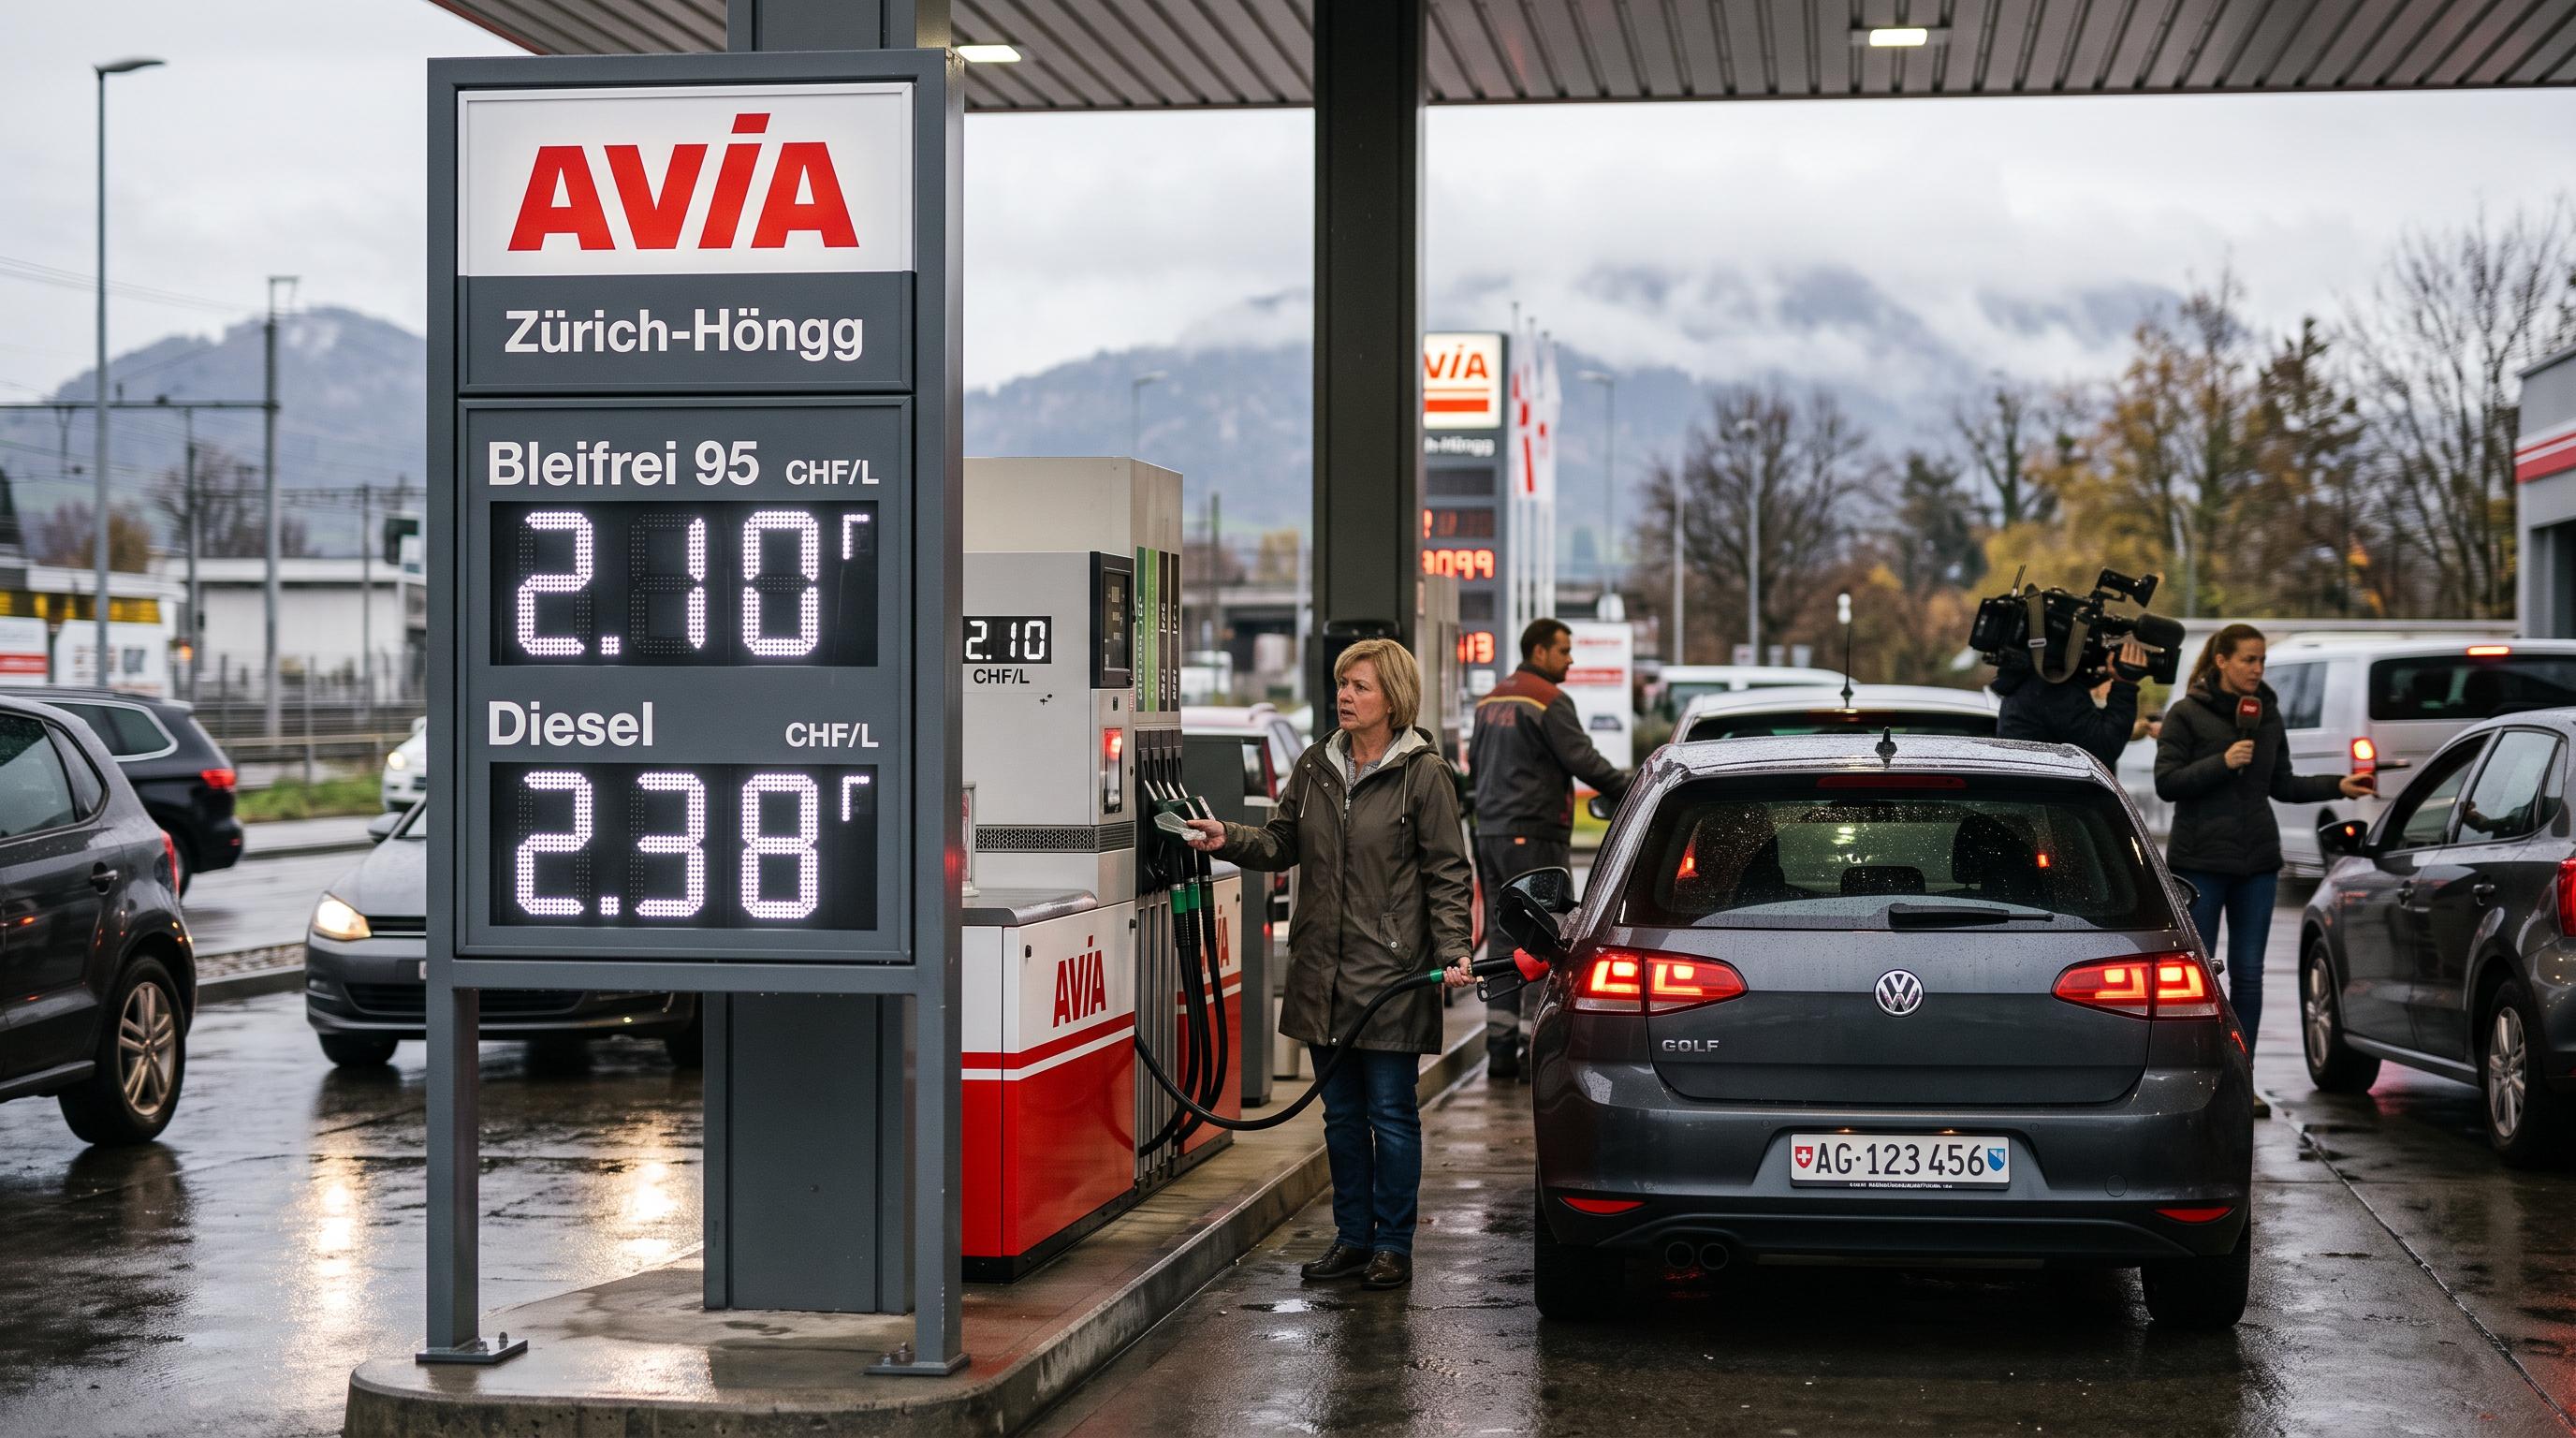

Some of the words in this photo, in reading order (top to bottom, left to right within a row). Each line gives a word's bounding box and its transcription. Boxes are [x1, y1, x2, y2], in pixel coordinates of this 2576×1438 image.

[505, 307, 864, 362] Zürich-Höngg
[1423, 344, 1488, 379] VIA
[489, 440, 677, 487] Bleifrei
[695, 440, 760, 487] 95
[785, 459, 880, 486] CHF/L
[517, 510, 821, 656] 2.10
[965, 620, 1046, 660] 2.10
[973, 668, 1031, 684] CHF/L
[489, 700, 654, 747] Diesel
[785, 722, 879, 748] CHF/L
[516, 771, 819, 918] 2.38
[1661, 1039, 1720, 1052] GOLF
